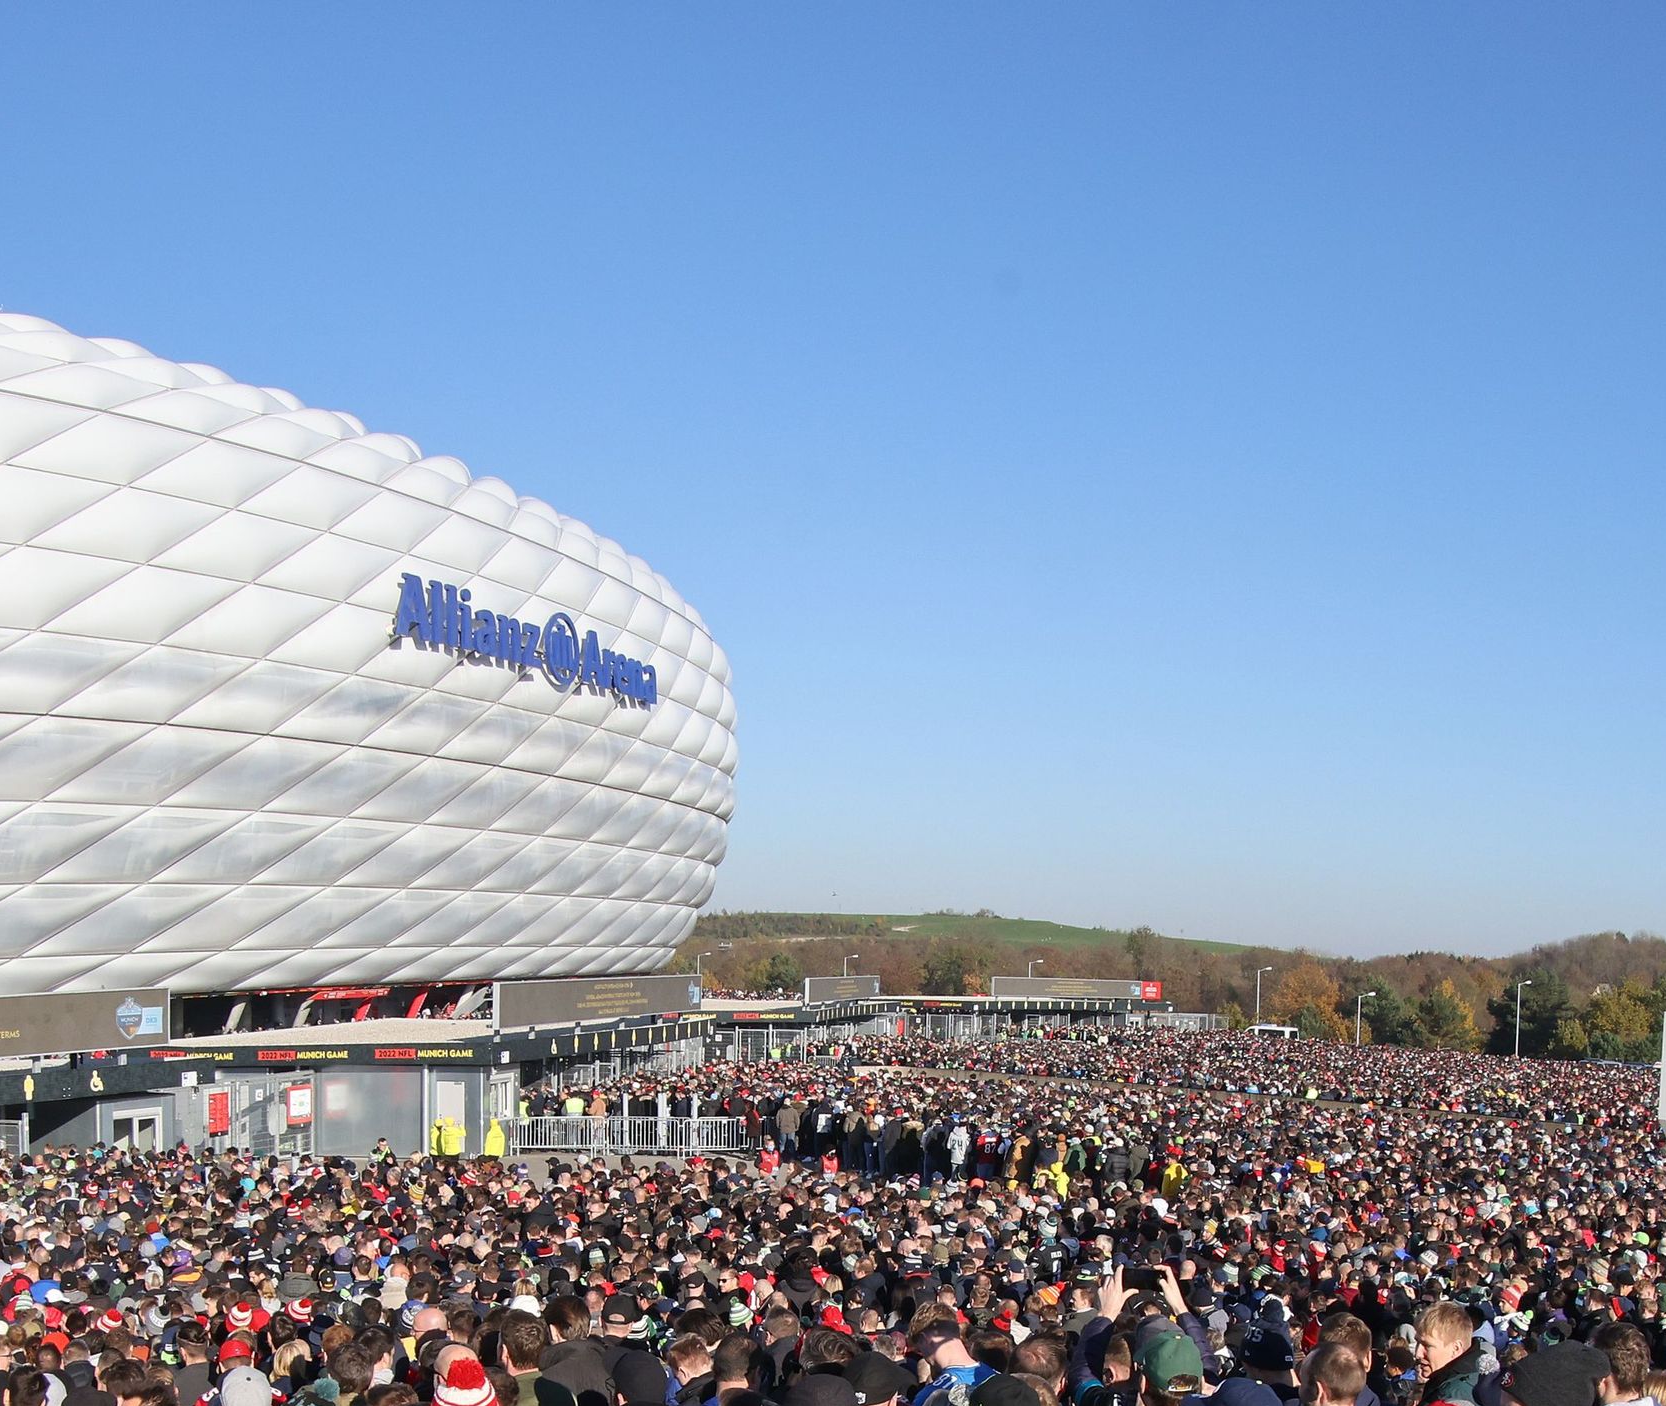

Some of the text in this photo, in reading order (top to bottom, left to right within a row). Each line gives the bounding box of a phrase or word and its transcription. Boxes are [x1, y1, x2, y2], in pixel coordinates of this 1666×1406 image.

[395, 572, 657, 704] Allianz Arena
[296, 1051, 325, 1059] MUNICH
[326, 1051, 349, 1059] GAME
[378, 1050, 395, 1058] 2022
[417, 1050, 448, 1058] MUNICH
[450, 1049, 473, 1057] GAME
